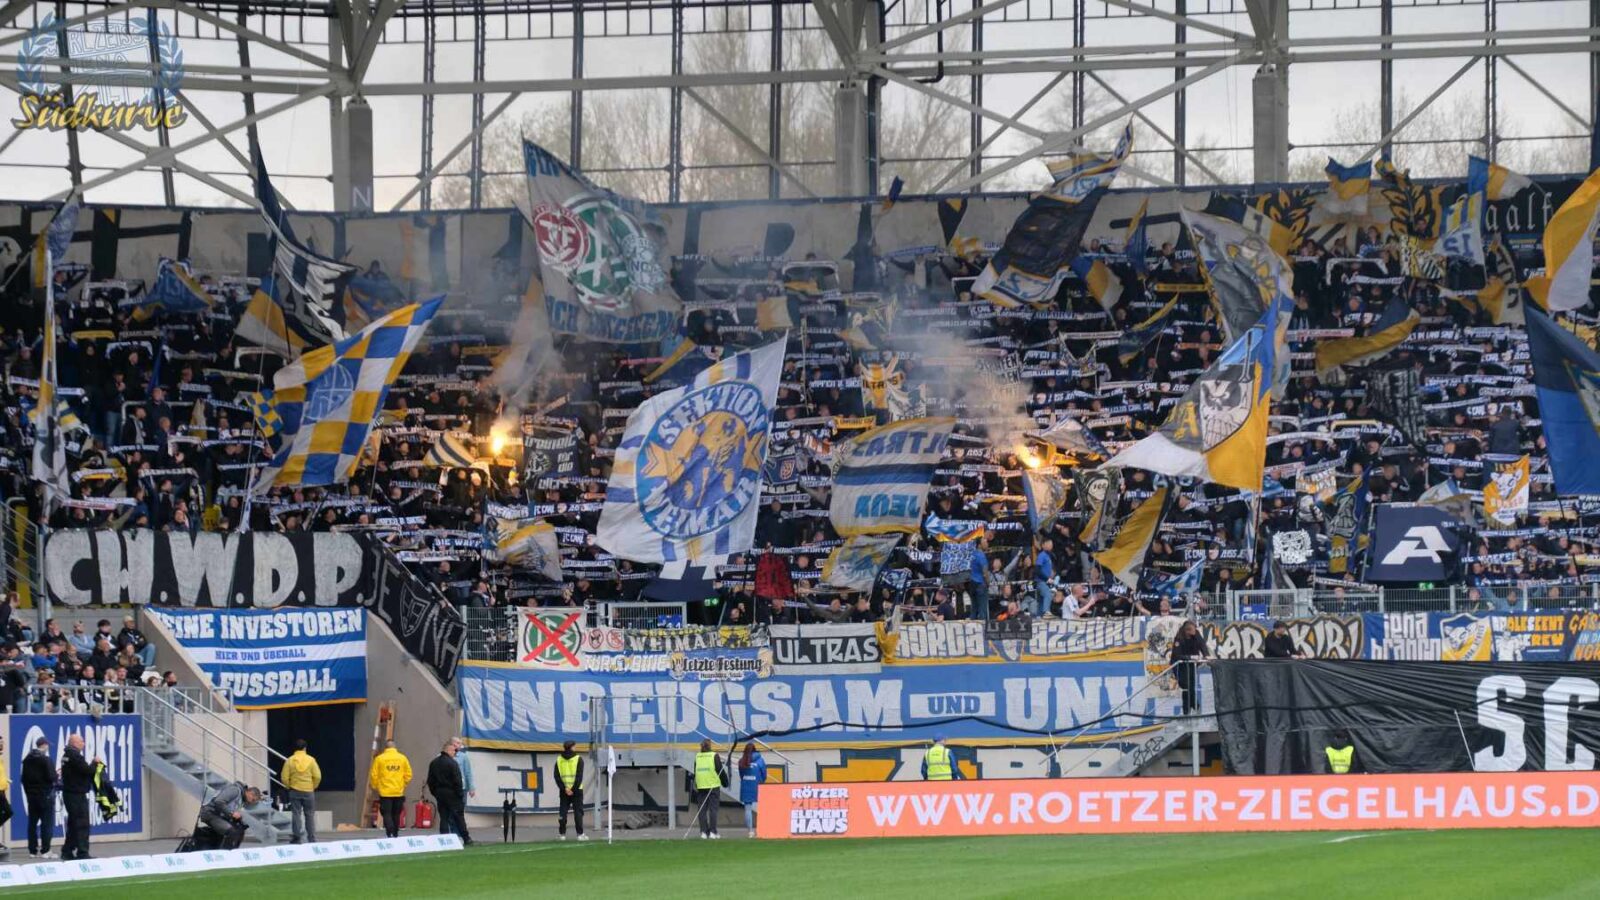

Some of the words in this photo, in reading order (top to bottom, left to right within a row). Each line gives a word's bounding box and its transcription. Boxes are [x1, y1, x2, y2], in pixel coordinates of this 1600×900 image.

[657, 383, 768, 446] SEKTION
[221, 607, 362, 641] INVESTOREN
[215, 649, 238, 661] HIER
[240, 649, 260, 661] UND
[263, 646, 306, 660] ÜBERALL
[776, 636, 880, 664] ULTRAS
[219, 667, 336, 698] FUSSBALL
[463, 677, 903, 734] UNBEUGSAM
[927, 695, 981, 716] UND
[118, 724, 134, 782] 11
[791, 785, 848, 799] RÖTZER
[867, 785, 1598, 827] WWW.ROETZER-ZIEGELHAUS.D
[790, 818, 848, 834] HAUS
[791, 808, 848, 819] ELEMENT
